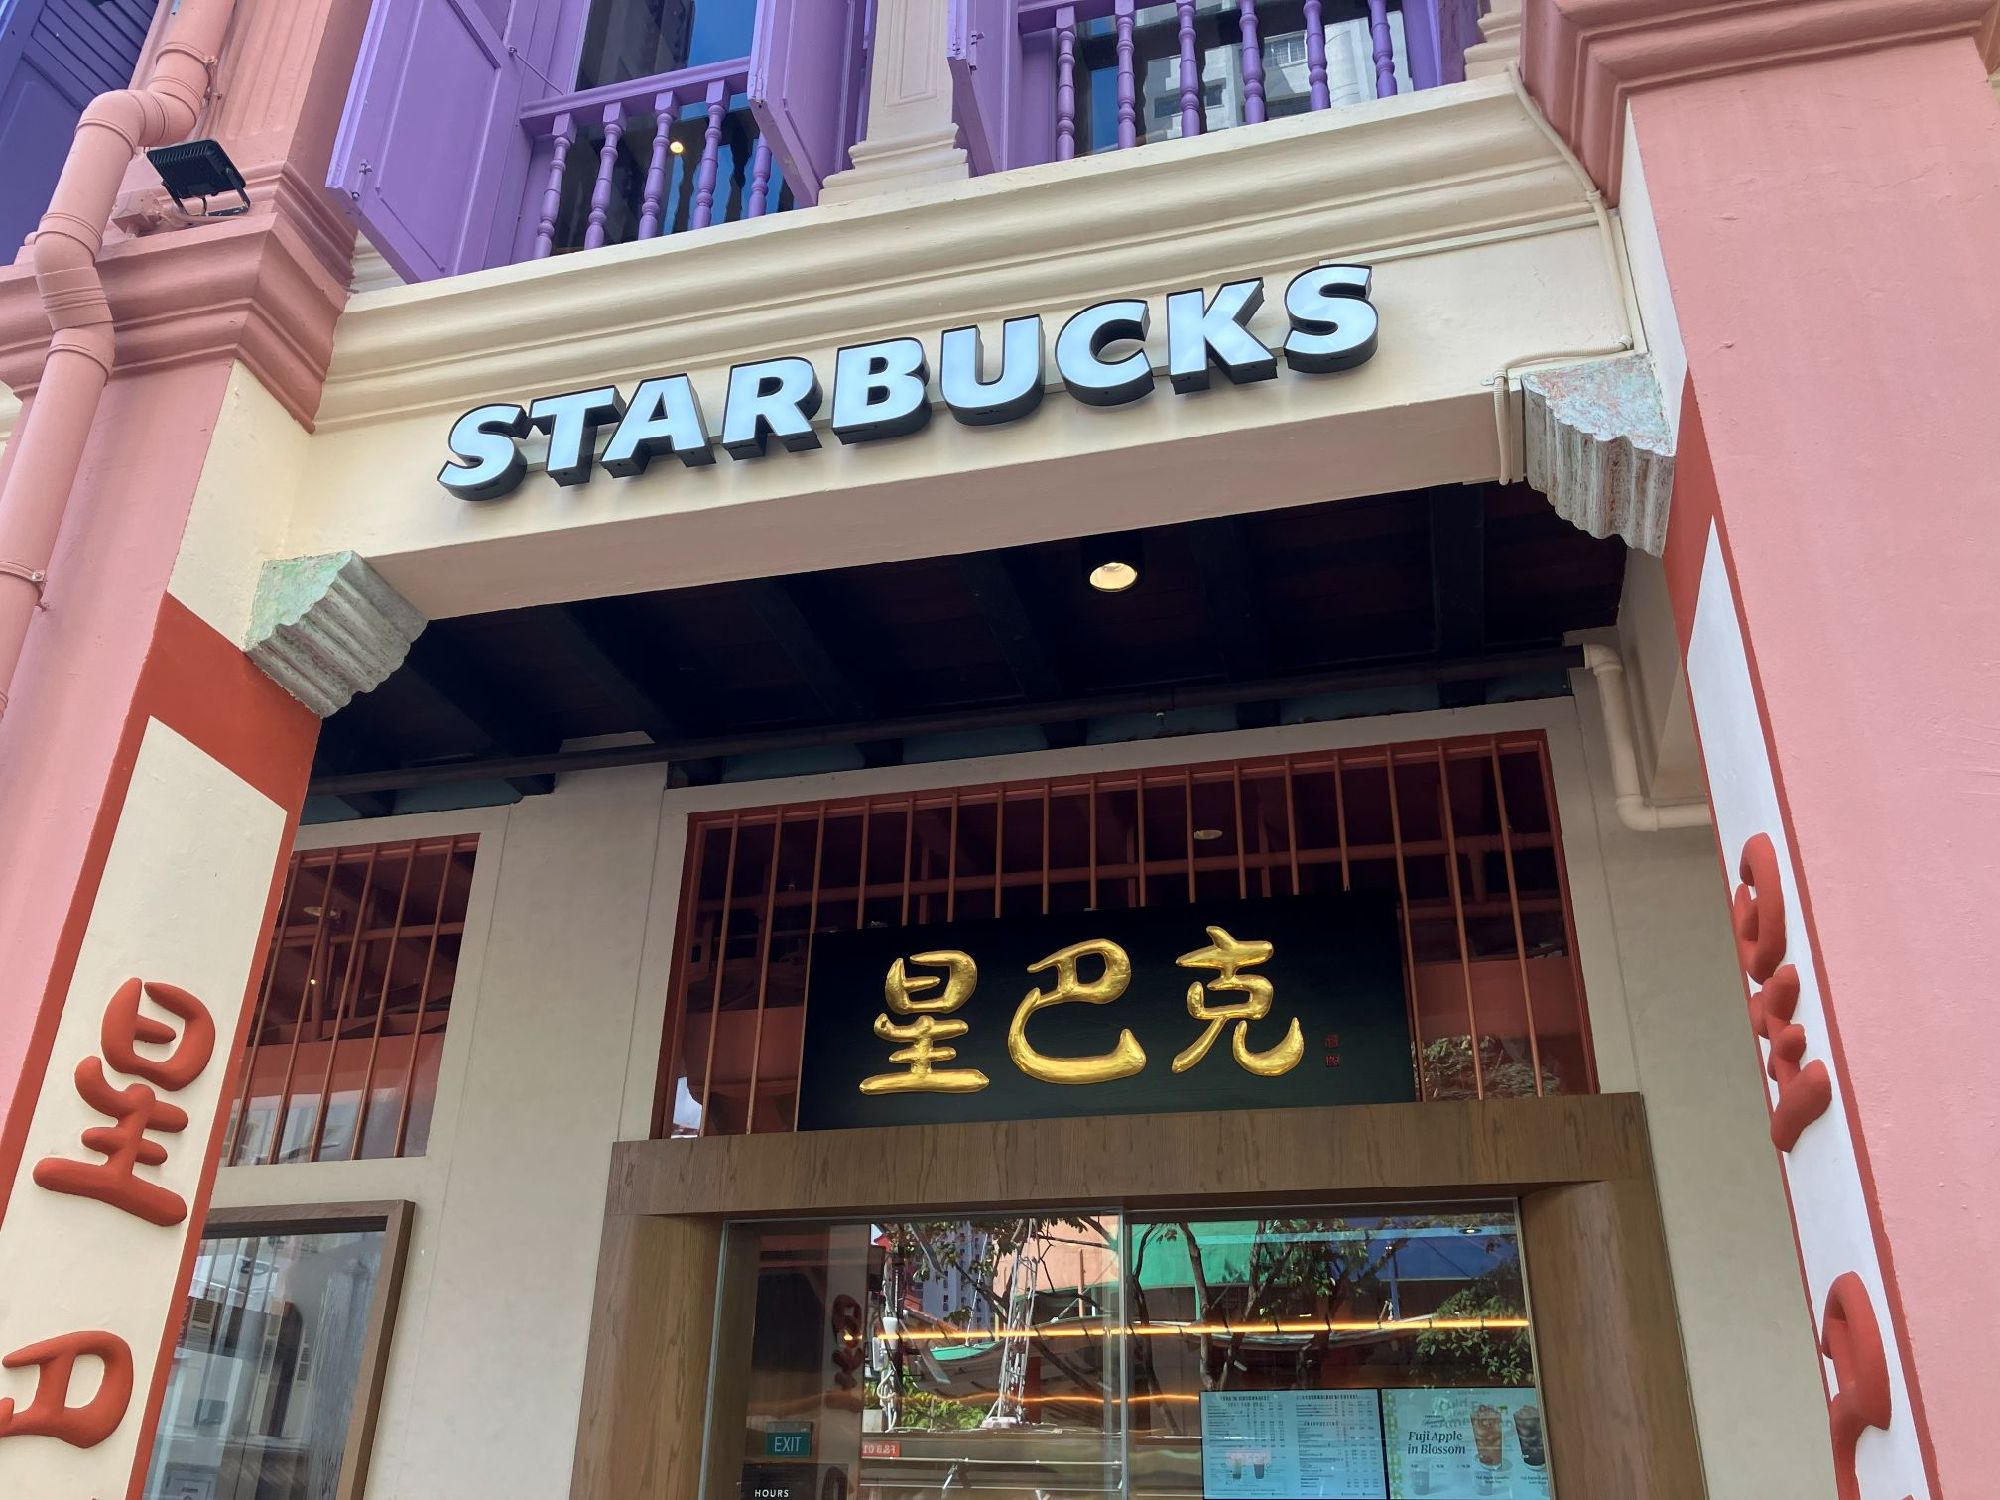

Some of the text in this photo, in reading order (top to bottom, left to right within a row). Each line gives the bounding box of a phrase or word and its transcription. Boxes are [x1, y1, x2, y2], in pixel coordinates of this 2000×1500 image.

[437, 263, 1379, 501] STARBUCKS
[859, 925, 1305, 1095] 星巴克
[1408, 1430, 1463, 1442] Fuji Apple
[774, 1436, 802, 1453] EXIT
[1407, 1443, 1466, 1455] in Blossom
[754, 1489, 790, 1498] HOURS
